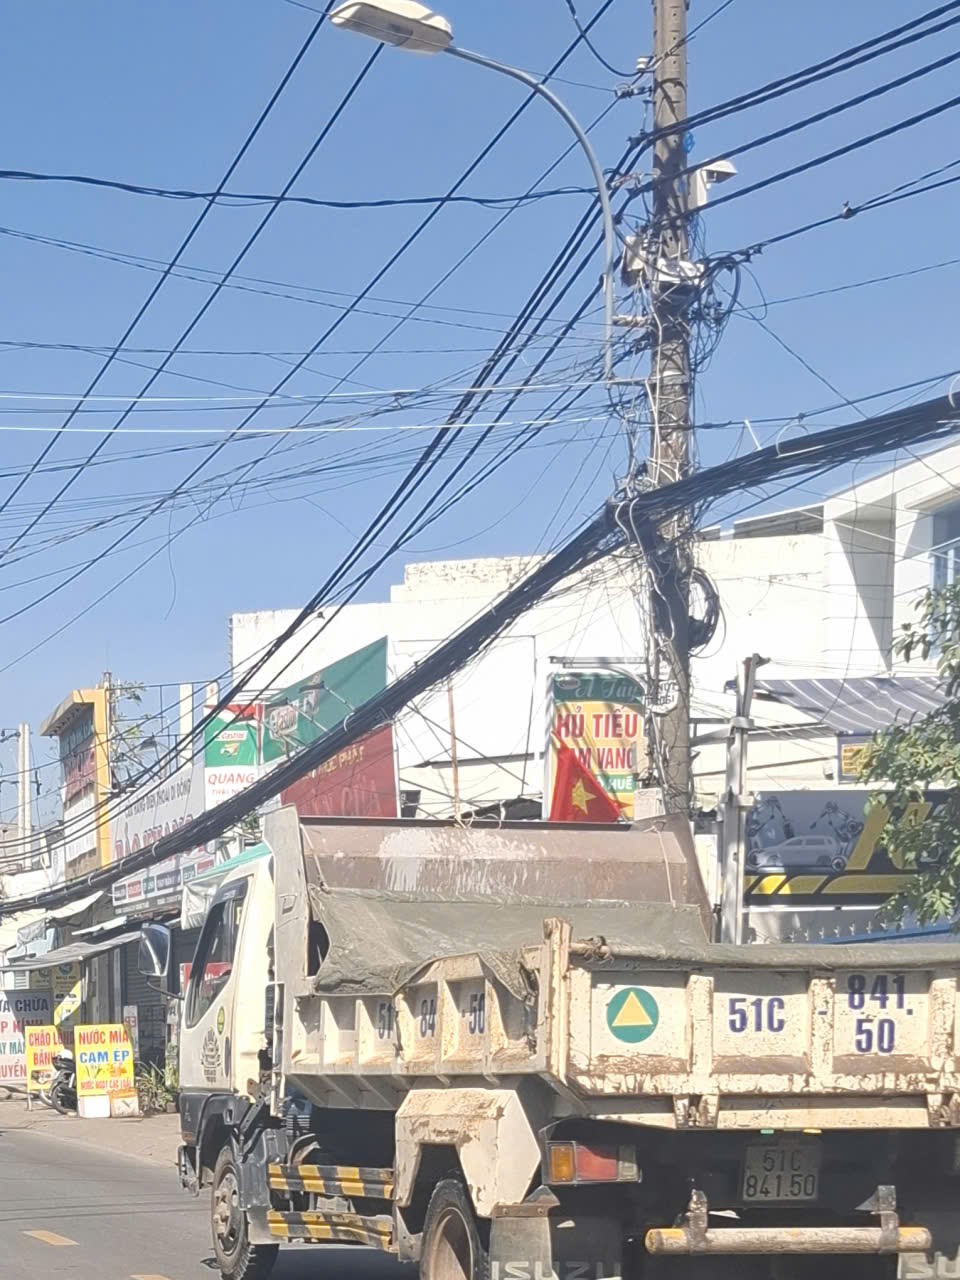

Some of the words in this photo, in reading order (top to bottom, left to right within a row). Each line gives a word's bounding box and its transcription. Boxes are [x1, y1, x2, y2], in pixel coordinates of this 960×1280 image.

[556, 706, 585, 738] HỦ
[592, 705, 638, 738] TIẾU
[208, 772, 255, 785] QUANG
[420, 999, 436, 1038] 84
[729, 997, 785, 1033] 51C
[855, 1018, 896, 1053] 50
[79, 1051, 109, 1064] CAM
[763, 1150, 802, 1173] 51C
[745, 1173, 817, 1198] 841.50
